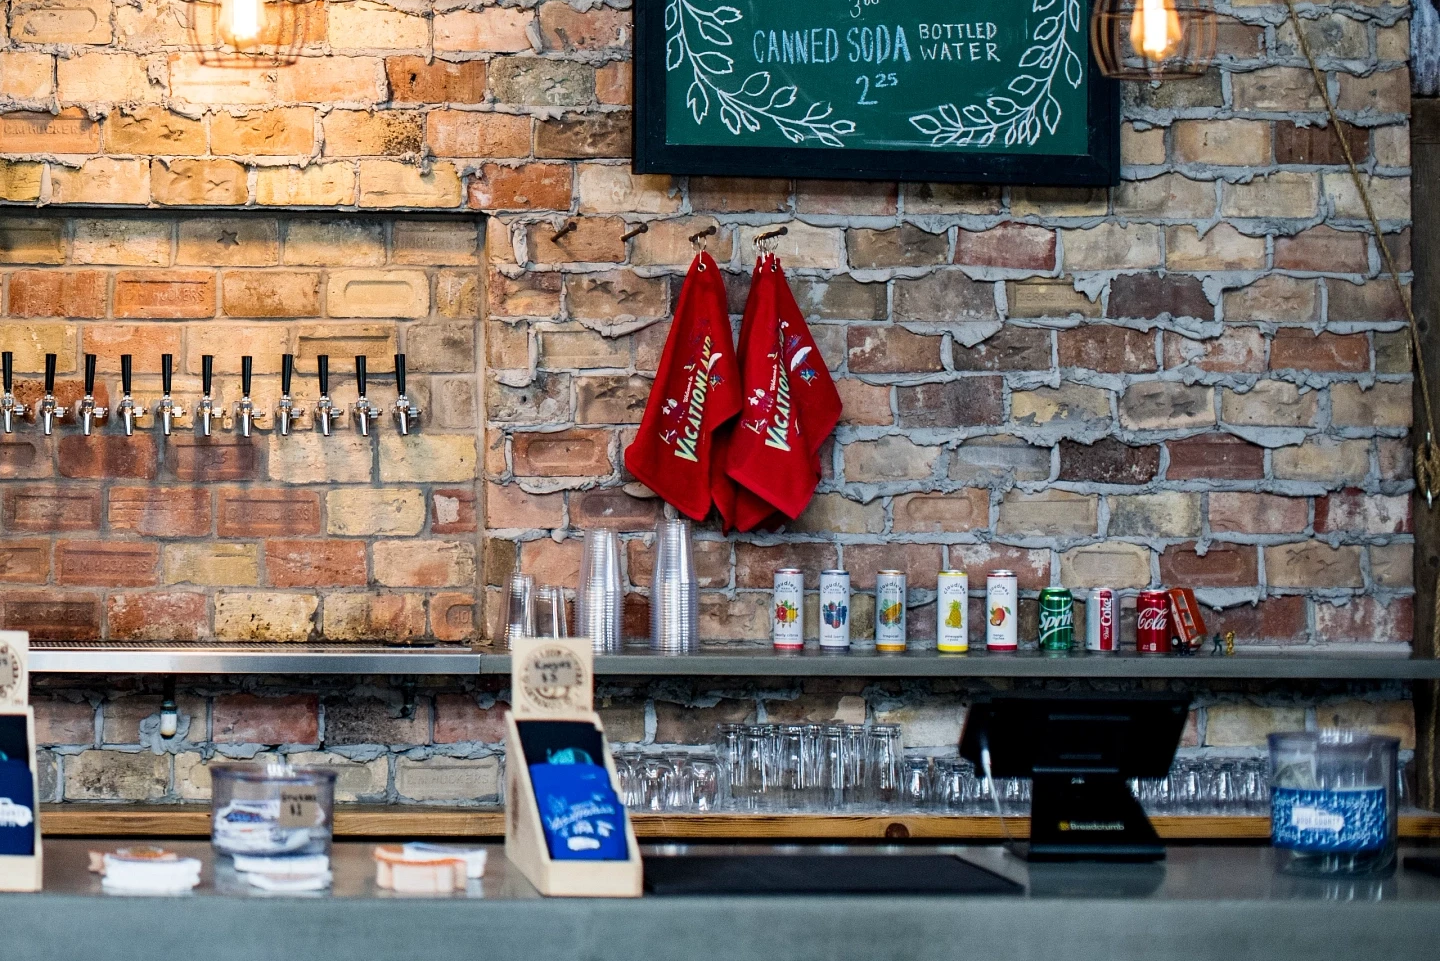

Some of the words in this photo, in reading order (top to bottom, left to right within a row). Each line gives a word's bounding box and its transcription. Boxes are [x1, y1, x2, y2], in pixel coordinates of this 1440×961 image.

[918, 22, 998, 41] BOTTLED
[753, 28, 840, 64] CANNED
[846, 25, 912, 64] SODA
[919, 42, 1001, 63] WATER
